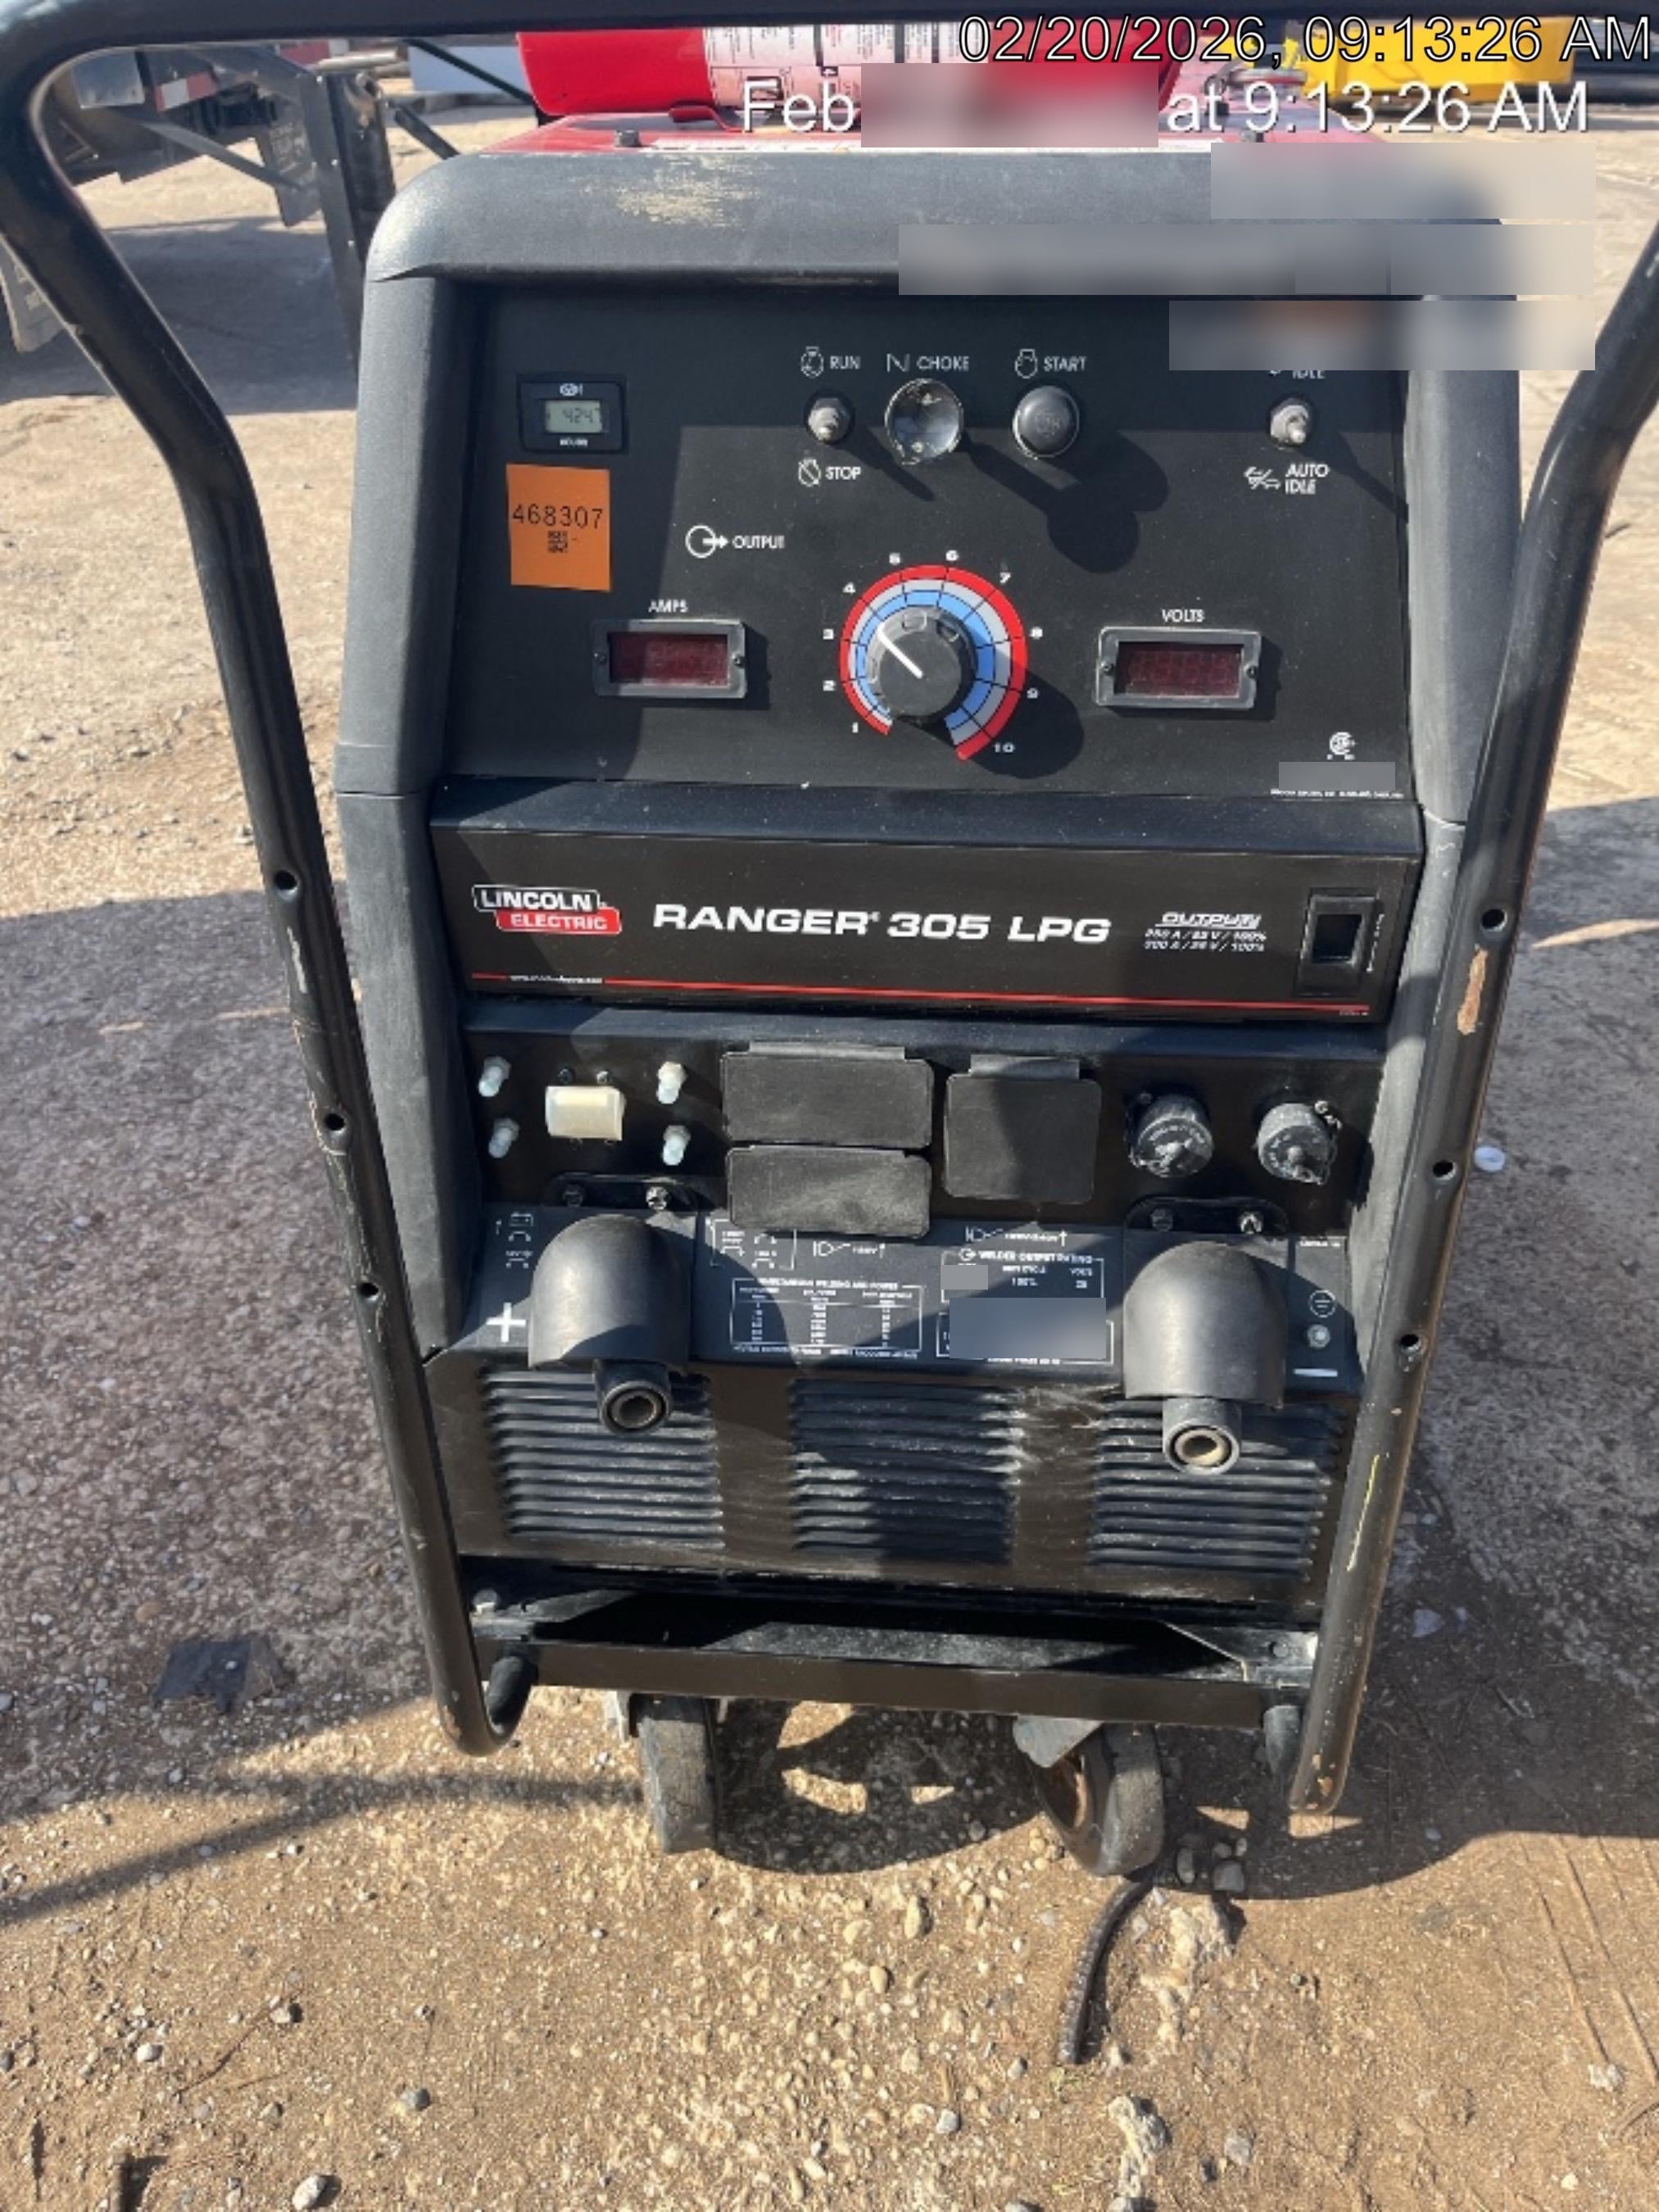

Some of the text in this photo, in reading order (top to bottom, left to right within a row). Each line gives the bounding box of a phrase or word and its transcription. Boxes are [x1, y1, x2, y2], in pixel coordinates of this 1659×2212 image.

[829, 356, 861, 369] RUN
[916, 356, 970, 370] CHOKE
[1043, 356, 1087, 371] START
[825, 465, 861, 480] STOP
[1285, 464, 1330, 478] AUTO
[1285, 478, 1317, 495] IDLE
[511, 504, 605, 530] 468307
[732, 535, 786, 550] OUTPUT
[842, 582, 856, 594] 4
[648, 600, 688, 614] AMPS
[1161, 608, 1205, 623] VOLTS
[851, 722, 859, 733] 1
[994, 742, 1015, 754] 10
[480, 888, 592, 912] LINCOLN
[510, 912, 608, 931] ELECTRIC
[886, 912, 992, 941] 305
[1008, 916, 1113, 944] LPG
